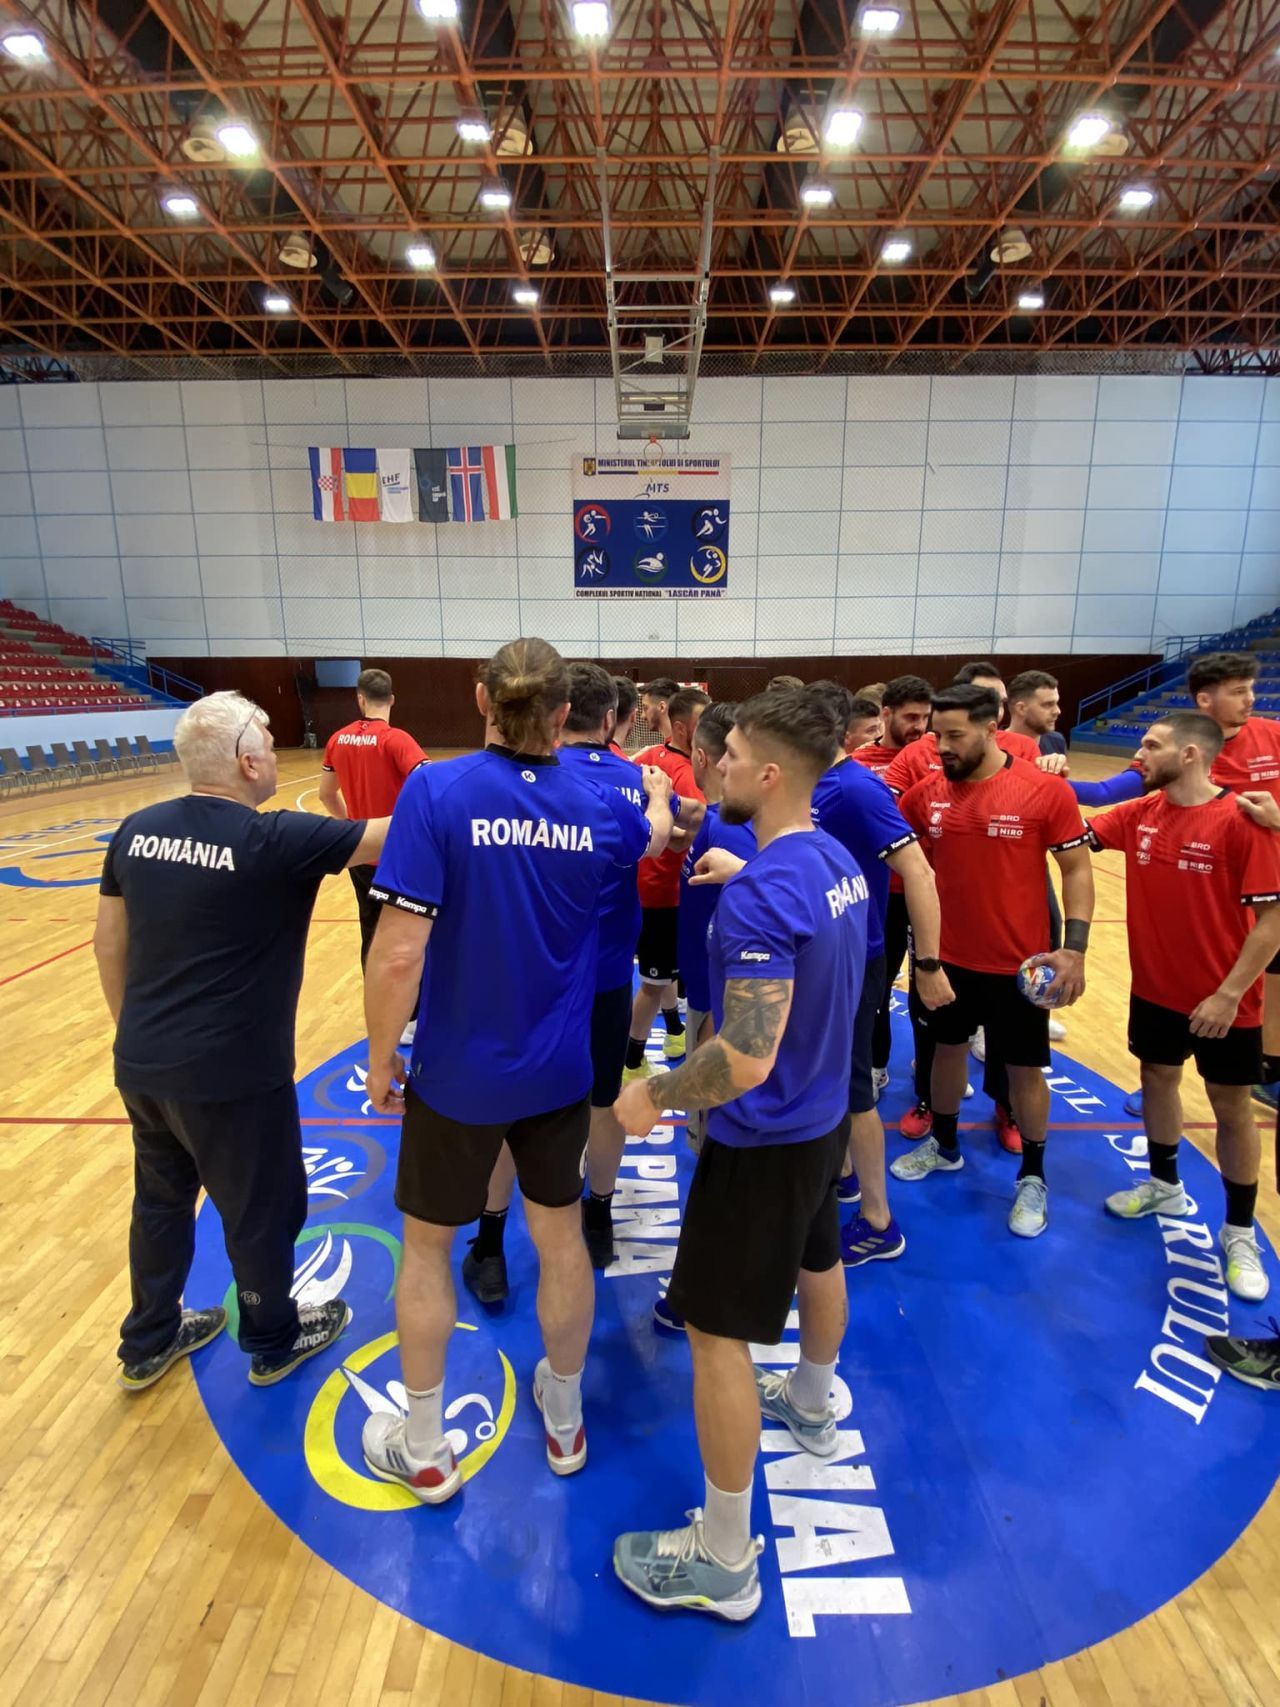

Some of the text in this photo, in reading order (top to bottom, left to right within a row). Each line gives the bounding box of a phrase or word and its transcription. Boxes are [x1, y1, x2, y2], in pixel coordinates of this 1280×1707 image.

[598, 459, 635, 467] MINISTERUL
[684, 459, 720, 467] SPORTULUI
[382, 473, 400, 485] EHF
[645, 483, 670, 493] MTS
[576, 590, 608, 598] COMPLEXUL
[609, 590, 634, 598] SPORTIV
[470, 817, 593, 852] ROMÂNIA
[396, 896, 428, 913] Kempa
[740, 950, 771, 962] Kempa
